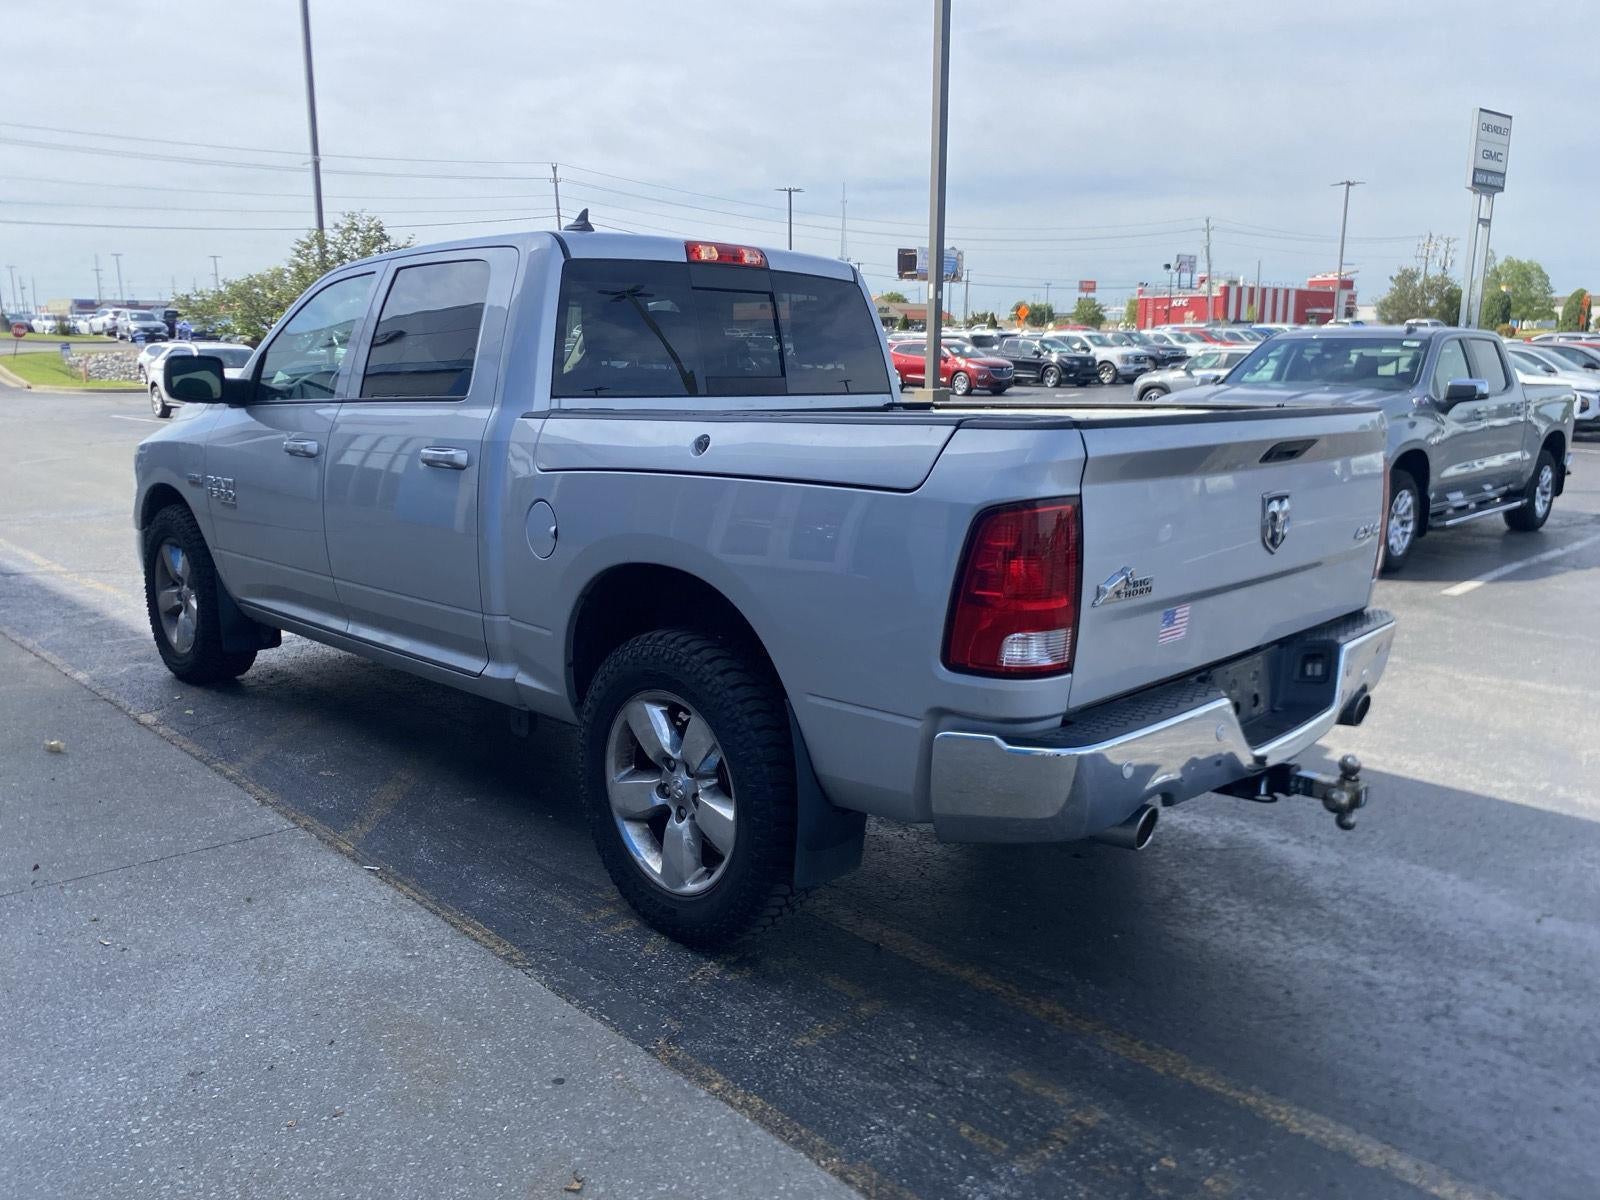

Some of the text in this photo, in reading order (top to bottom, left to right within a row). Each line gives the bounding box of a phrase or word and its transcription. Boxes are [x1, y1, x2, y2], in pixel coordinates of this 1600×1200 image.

[1481, 122, 1509, 137] CHEVROLET
[1482, 149, 1503, 162] GMC
[1171, 298, 1190, 307] KFC
[1132, 577, 1150, 589] BIG
[1124, 586, 1152, 598] HORN
